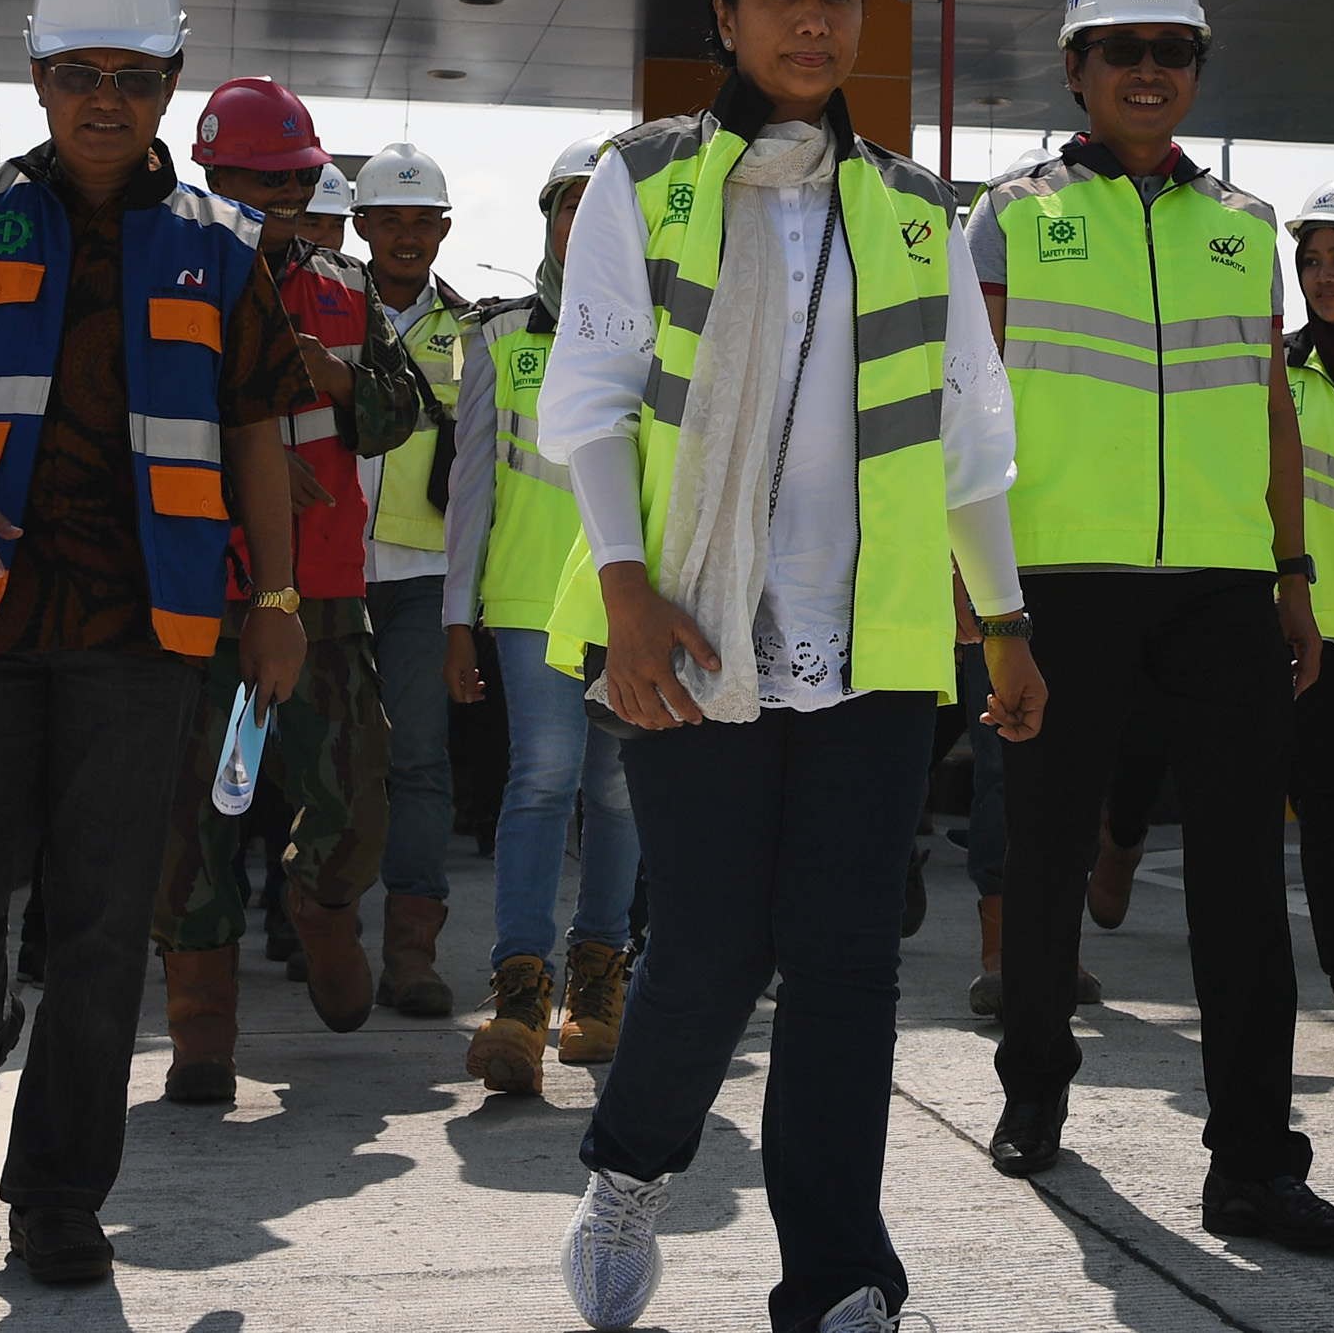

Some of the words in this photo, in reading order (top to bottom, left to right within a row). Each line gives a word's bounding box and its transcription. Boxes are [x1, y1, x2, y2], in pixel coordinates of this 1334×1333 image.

[1042, 248, 1065, 258] SAFETY
[1067, 248, 1084, 256] FIRST
[1210, 255, 1246, 274] WASKITA
